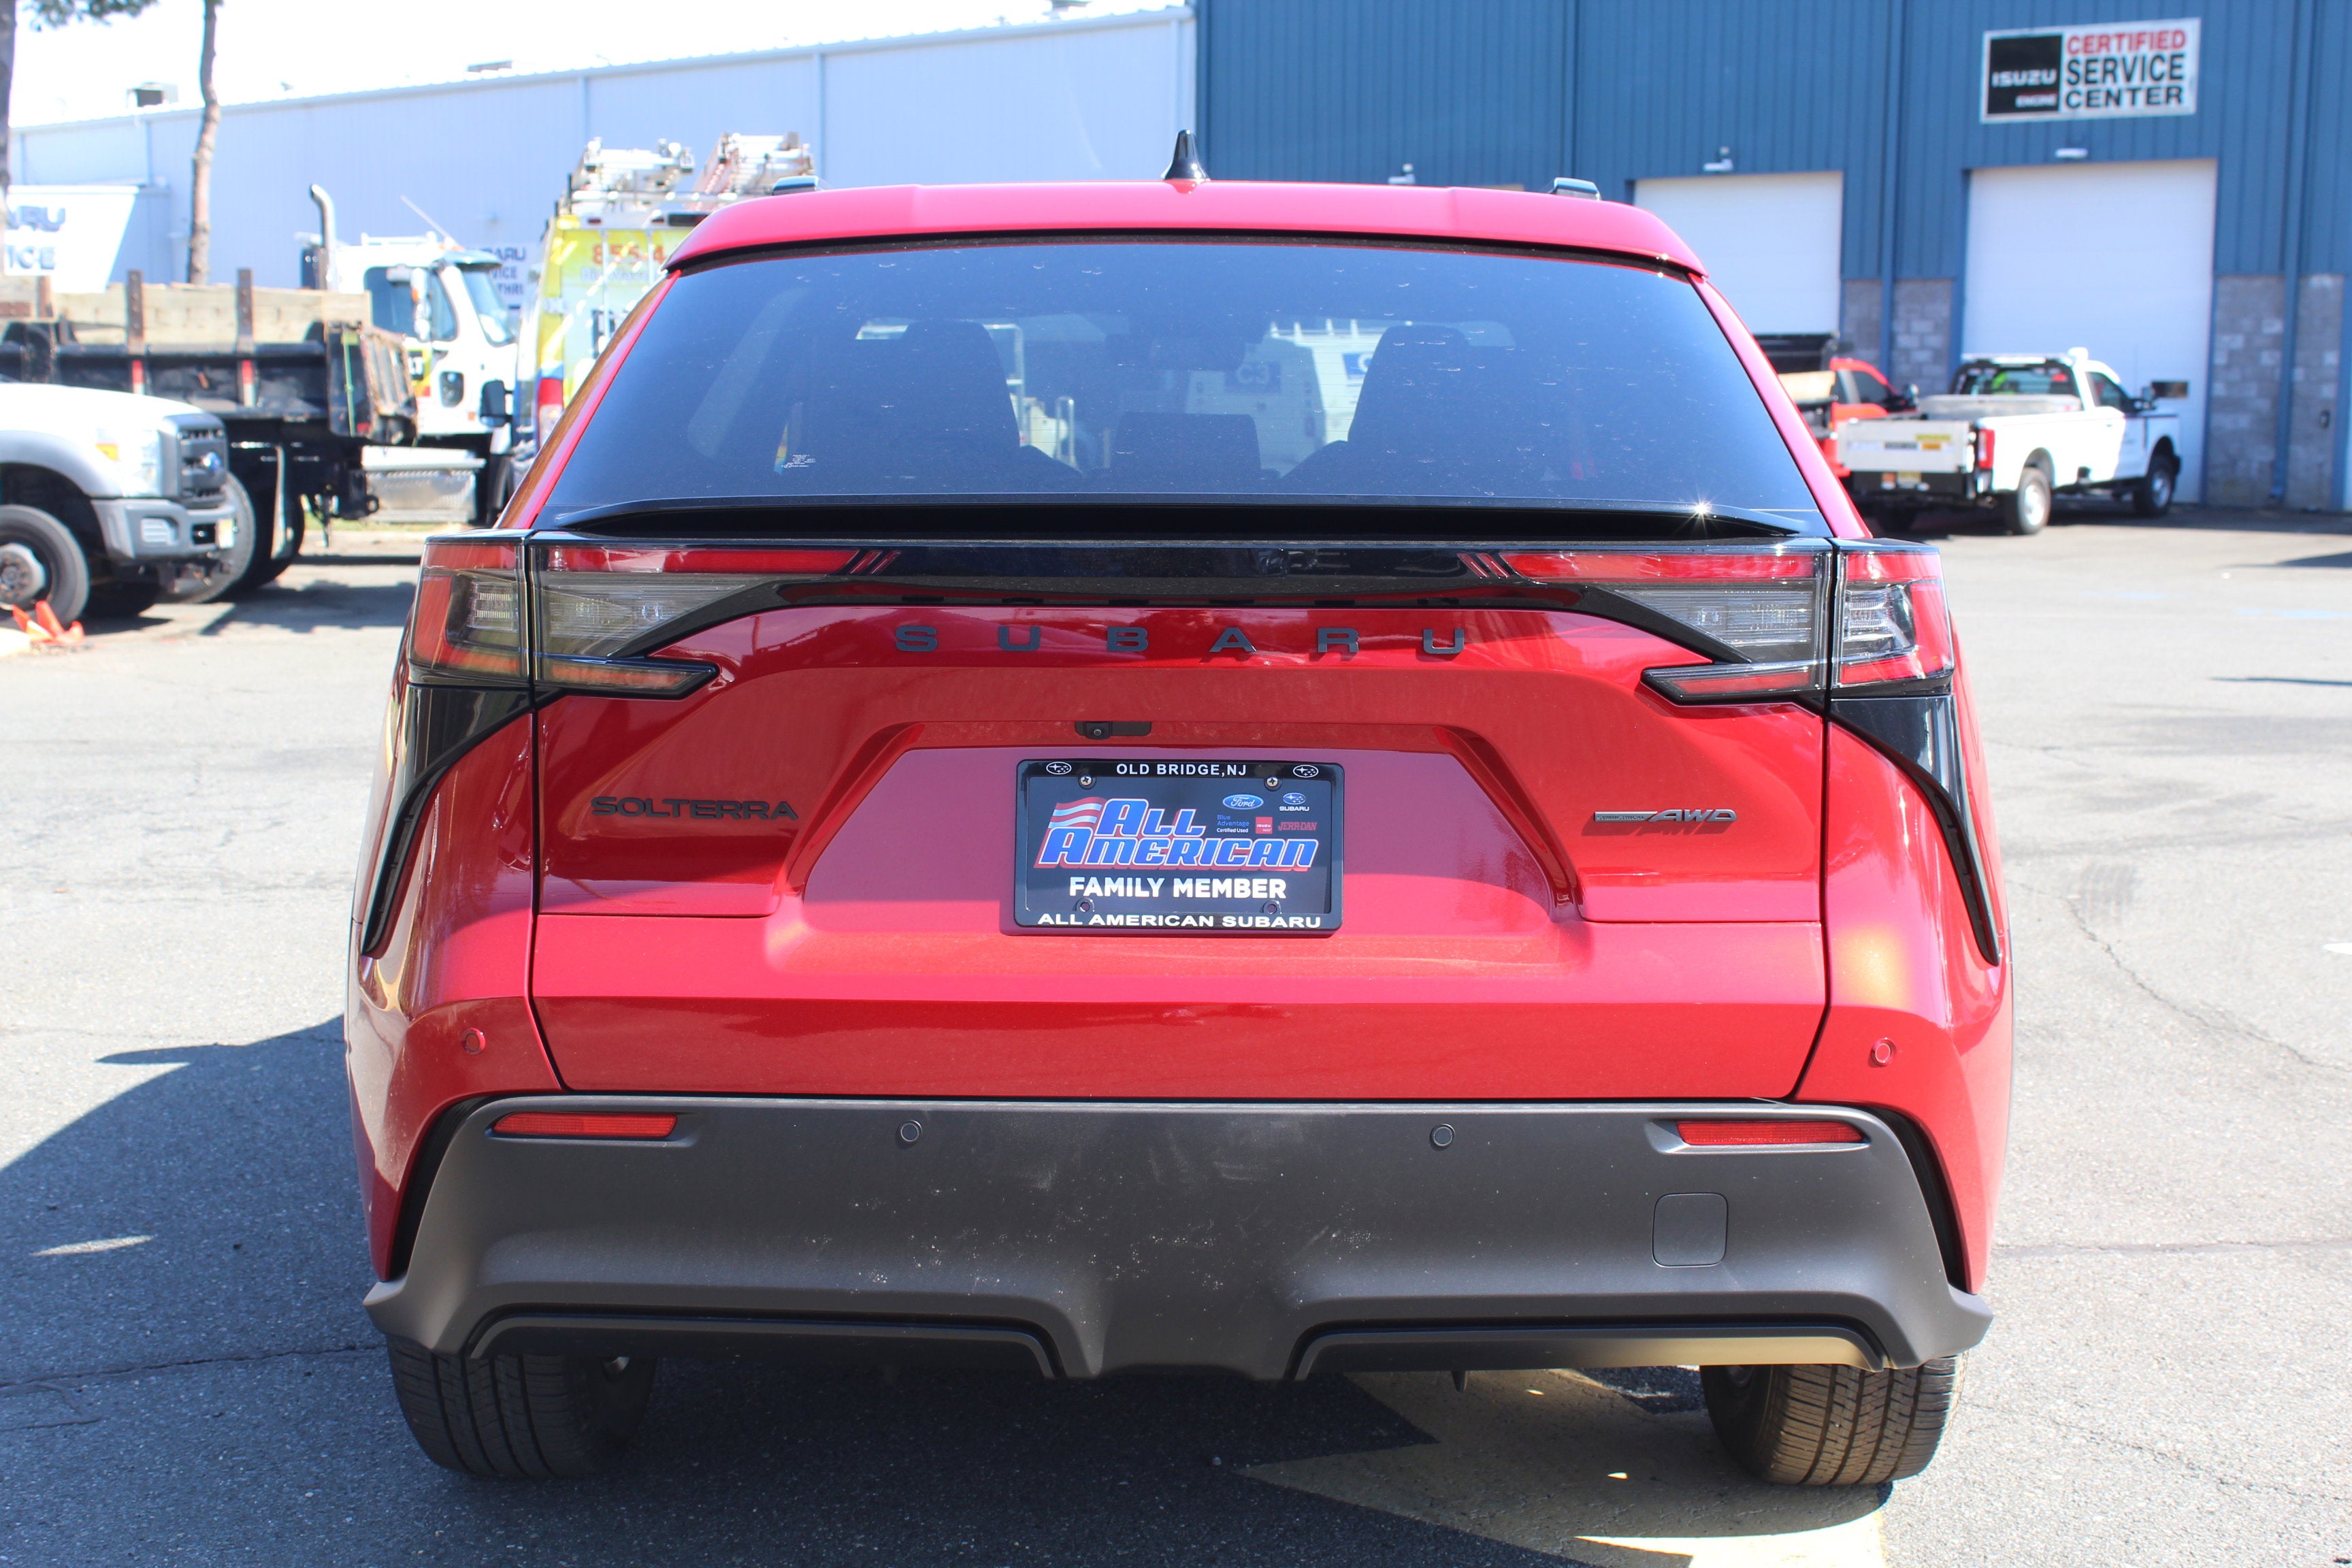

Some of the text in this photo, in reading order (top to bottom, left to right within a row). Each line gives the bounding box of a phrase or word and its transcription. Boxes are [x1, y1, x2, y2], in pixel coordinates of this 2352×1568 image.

[2066, 30, 2186, 55] CERTIFIED
[1991, 69, 2057, 87] ISUZU
[2066, 54, 2185, 86] SERVICE
[2064, 86, 2183, 110] CENTER
[895, 625, 1465, 655] SUBARU
[1116, 764, 1247, 777] OLD BRIDGE,NJ
[591, 796, 799, 821] SOLTERRA
[1230, 796, 1255, 807] Ford
[1648, 808, 1737, 822] AWD
[1069, 877, 1286, 898] FAMILY MEMBER
[1037, 913, 1322, 928] ALL AMERICAN SUBARU
